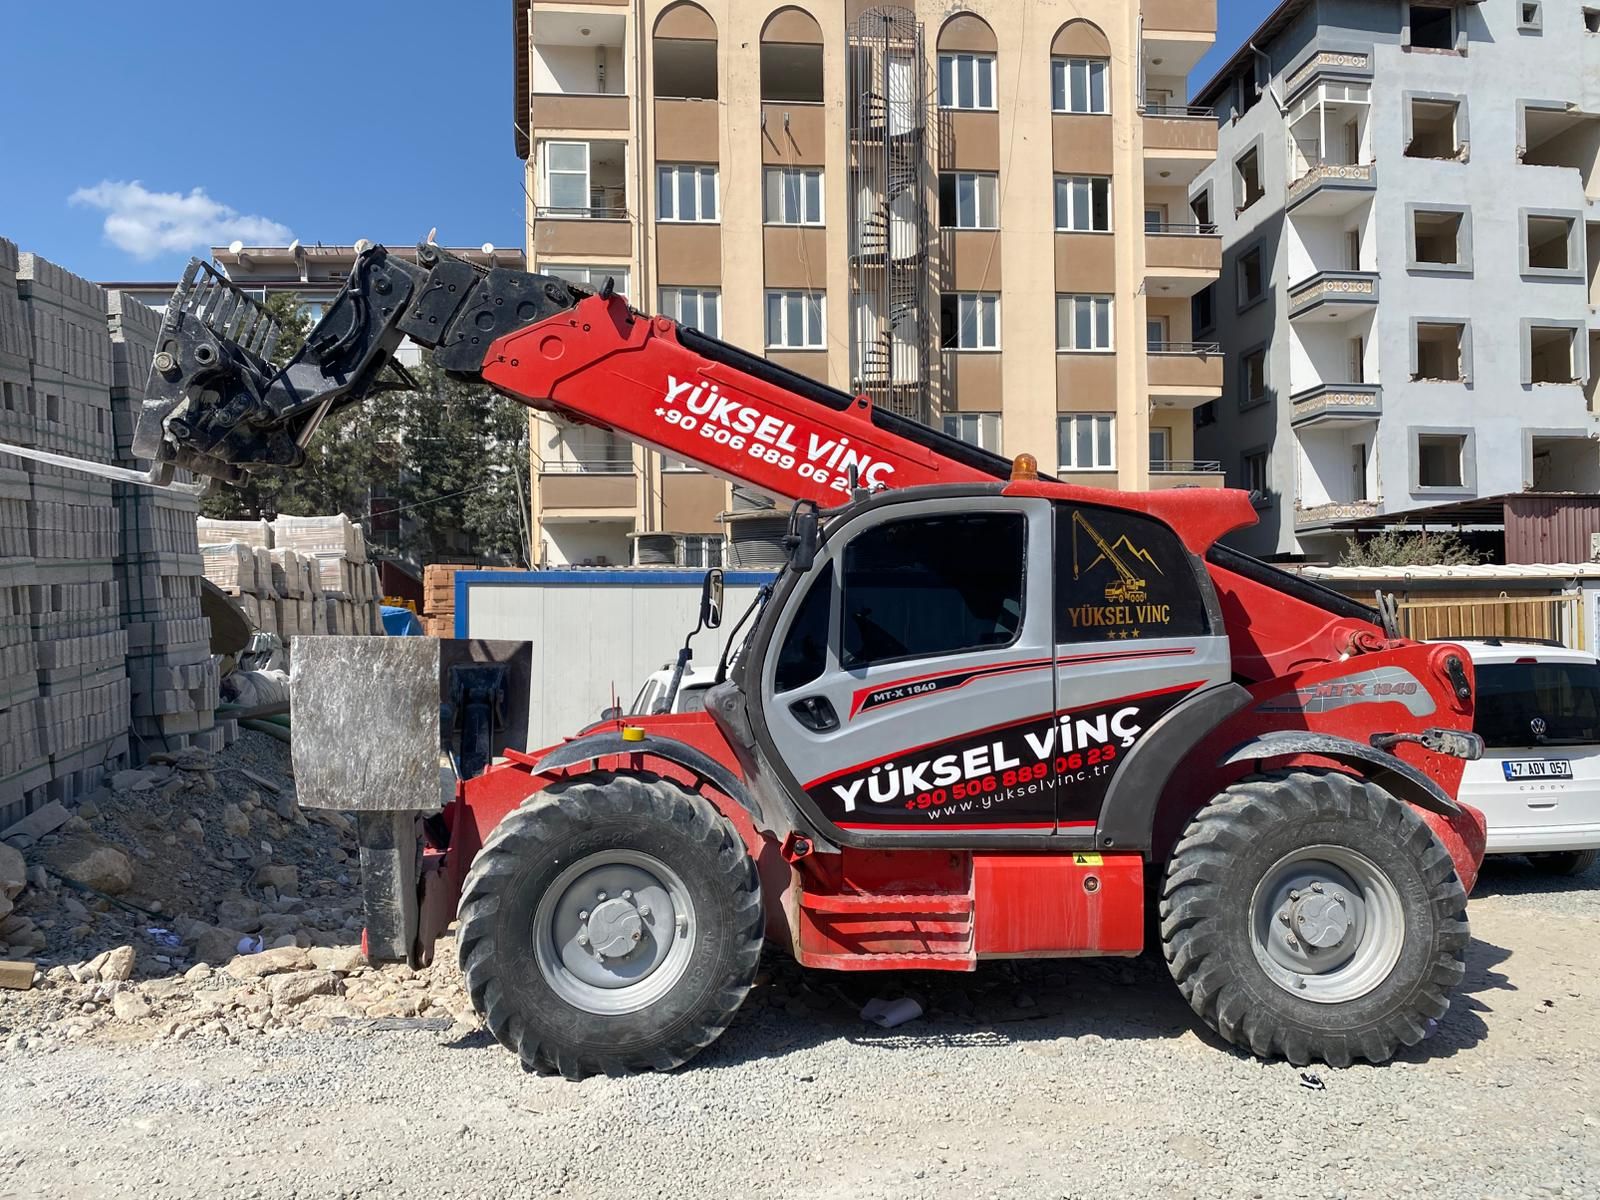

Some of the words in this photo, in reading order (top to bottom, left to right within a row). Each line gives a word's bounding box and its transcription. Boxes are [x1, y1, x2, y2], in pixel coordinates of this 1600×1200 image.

[654, 407, 697, 431] +90
[699, 421, 745, 450] 506
[748, 444, 796, 470] 889
[797, 462, 830, 484] 06
[663, 375, 796, 452] YÜKSEL
[807, 433, 896, 493] VİNÇ
[1068, 604, 1134, 627] YÜKSEL
[1136, 603, 1170, 625] VİNÇ
[873, 689, 905, 702] MT-X
[907, 682, 936, 695] 1840
[1314, 683, 1368, 697] MT-X
[1373, 682, 1417, 695] 1840
[831, 741, 1020, 813] YÜKSEL
[1023, 706, 1142, 760] VİNÇ
[905, 788, 947, 812] +90
[952, 776, 997, 801] 506
[1002, 763, 1048, 787] 889
[1053, 752, 1083, 773] 06
[1087, 744, 1117, 766] 23
[1511, 763, 1523, 776] 47
[1529, 762, 1546, 775] ADV
[1550, 761, 1567, 774] 057
[927, 763, 1110, 820] www.yukselvinc.tr
